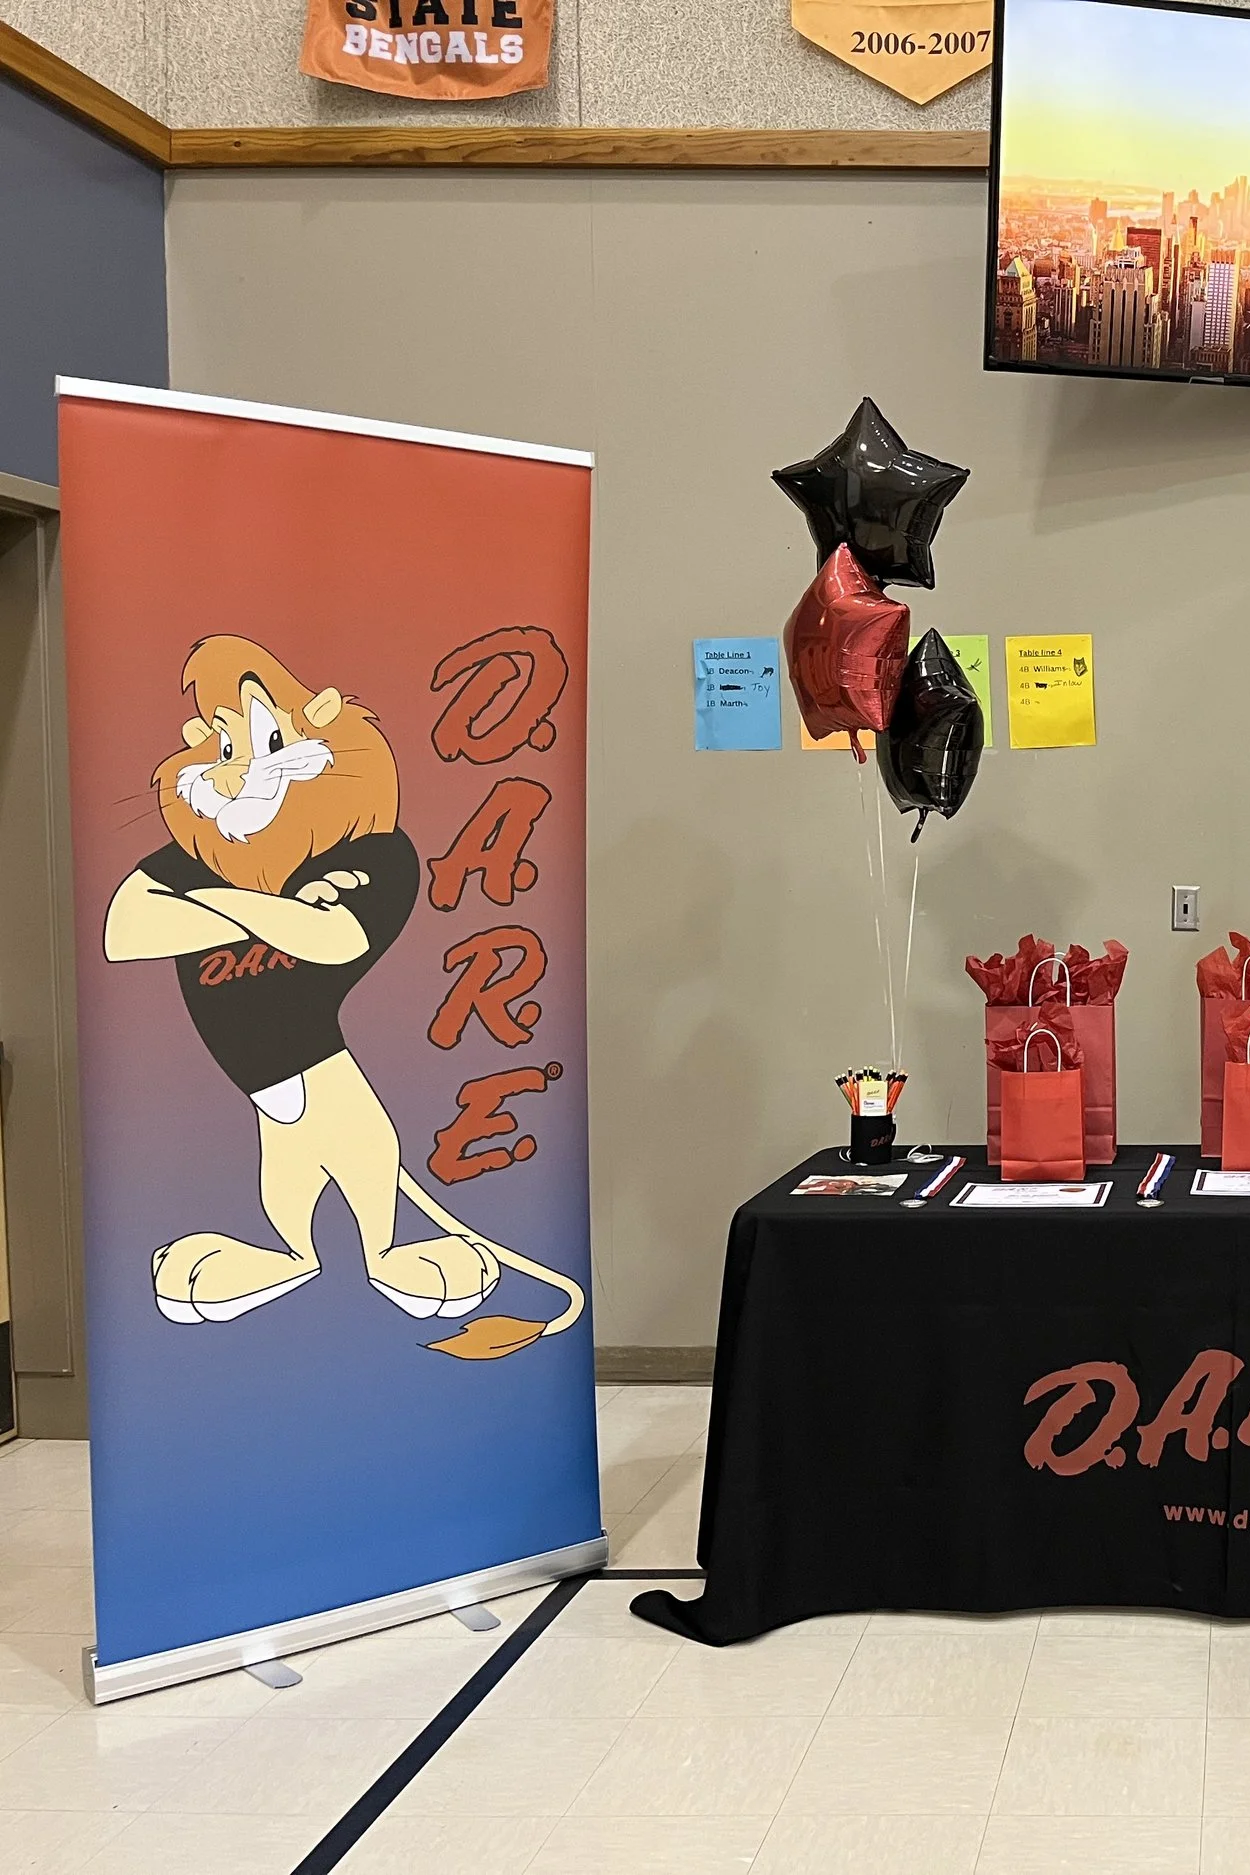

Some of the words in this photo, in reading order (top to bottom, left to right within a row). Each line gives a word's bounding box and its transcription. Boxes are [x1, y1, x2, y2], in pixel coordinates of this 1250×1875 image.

[343, 24, 524, 64] BENGALS
[850, 30, 992, 56] 2006-2007
[705, 651, 725, 660] Table
[727, 651, 745, 660] Line
[746, 651, 752, 659] 1
[1019, 649, 1039, 657] Table
